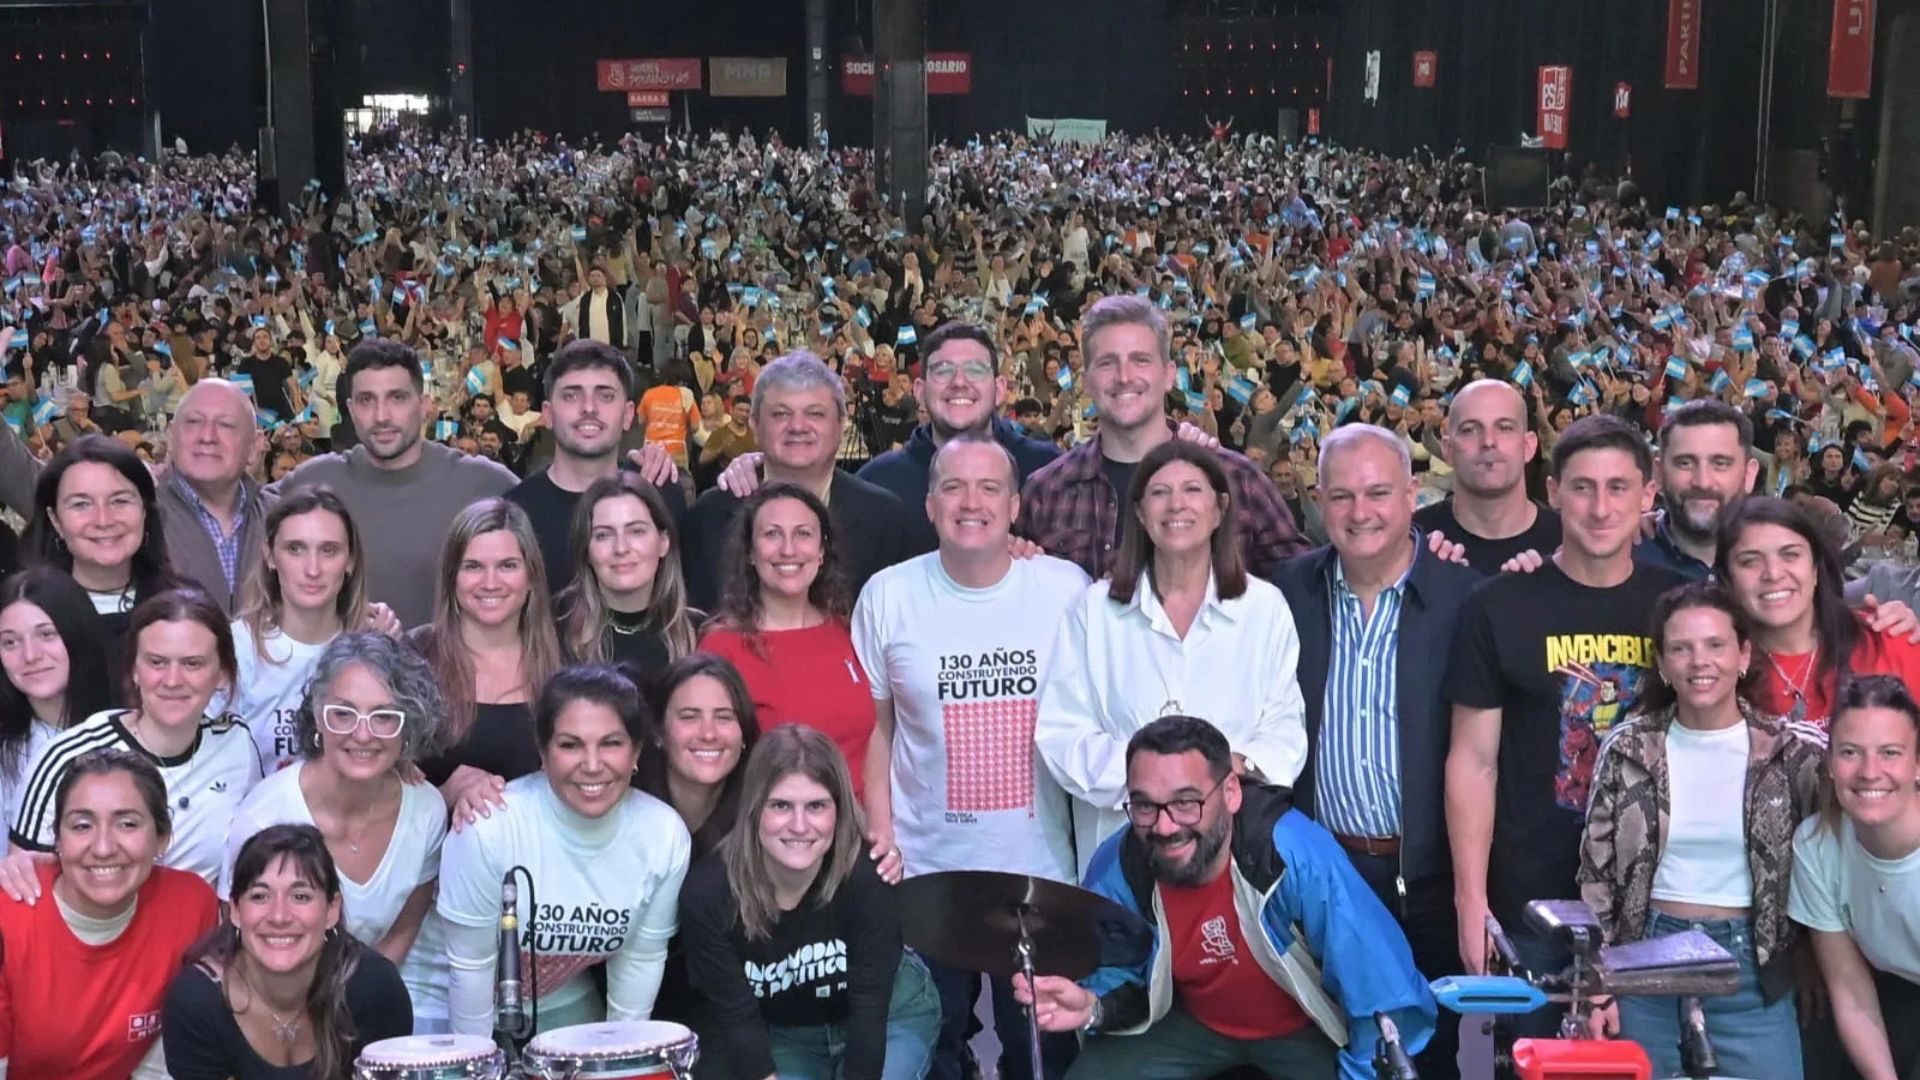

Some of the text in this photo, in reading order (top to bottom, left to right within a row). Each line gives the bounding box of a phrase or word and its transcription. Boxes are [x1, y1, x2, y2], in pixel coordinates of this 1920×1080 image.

[1679, 0, 1691, 75] PARTI
[926, 61, 967, 73] OSARIO
[939, 647, 1037, 671] 130 AÑOS
[938, 665, 1037, 681] CONSTRUYENDO
[938, 676, 1037, 700] FUTURO
[274, 709, 296, 724] 13
[570, 902, 630, 925] AÑOS
